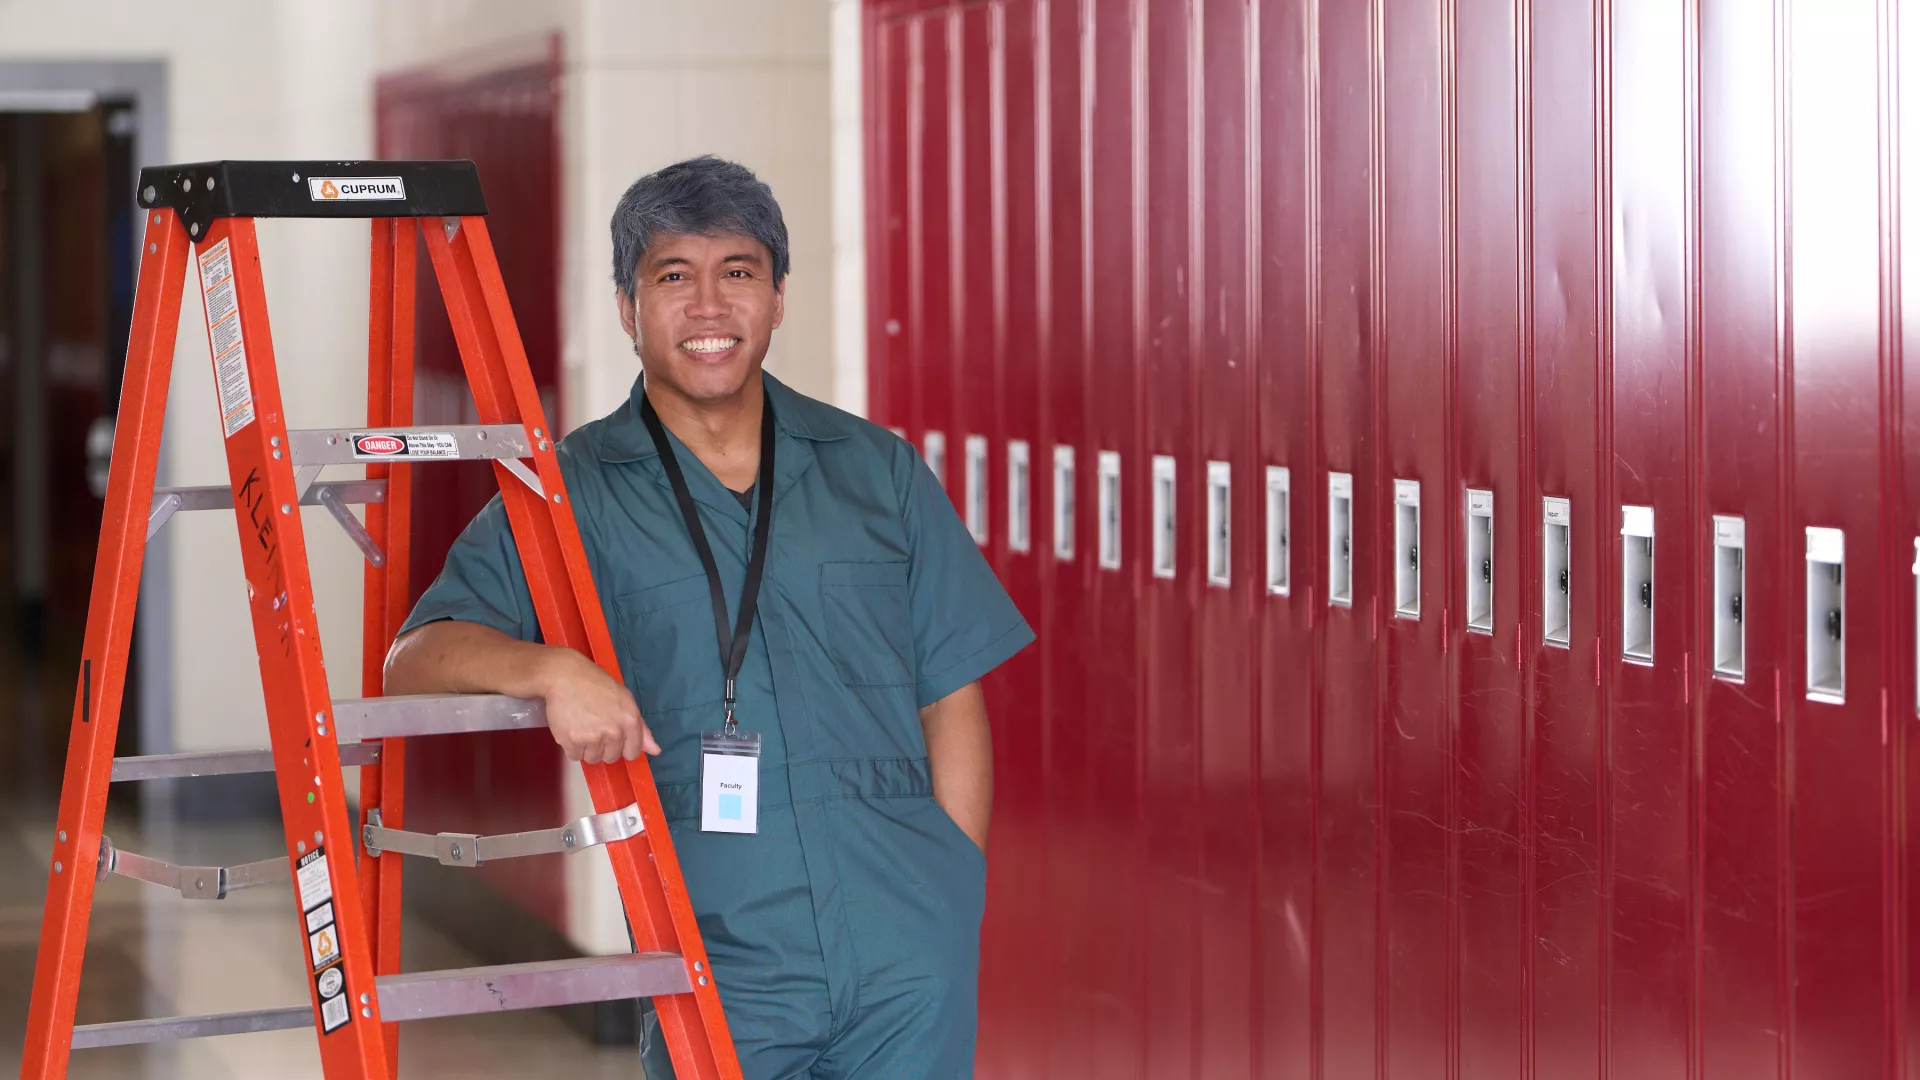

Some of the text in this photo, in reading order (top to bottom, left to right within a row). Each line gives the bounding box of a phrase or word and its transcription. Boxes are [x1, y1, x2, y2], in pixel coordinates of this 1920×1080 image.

[341, 184, 396, 194] CUPRUM
[365, 441, 397, 450] DANGER
[720, 782, 742, 790] Faculty
[301, 849, 320, 867] NOTICE
